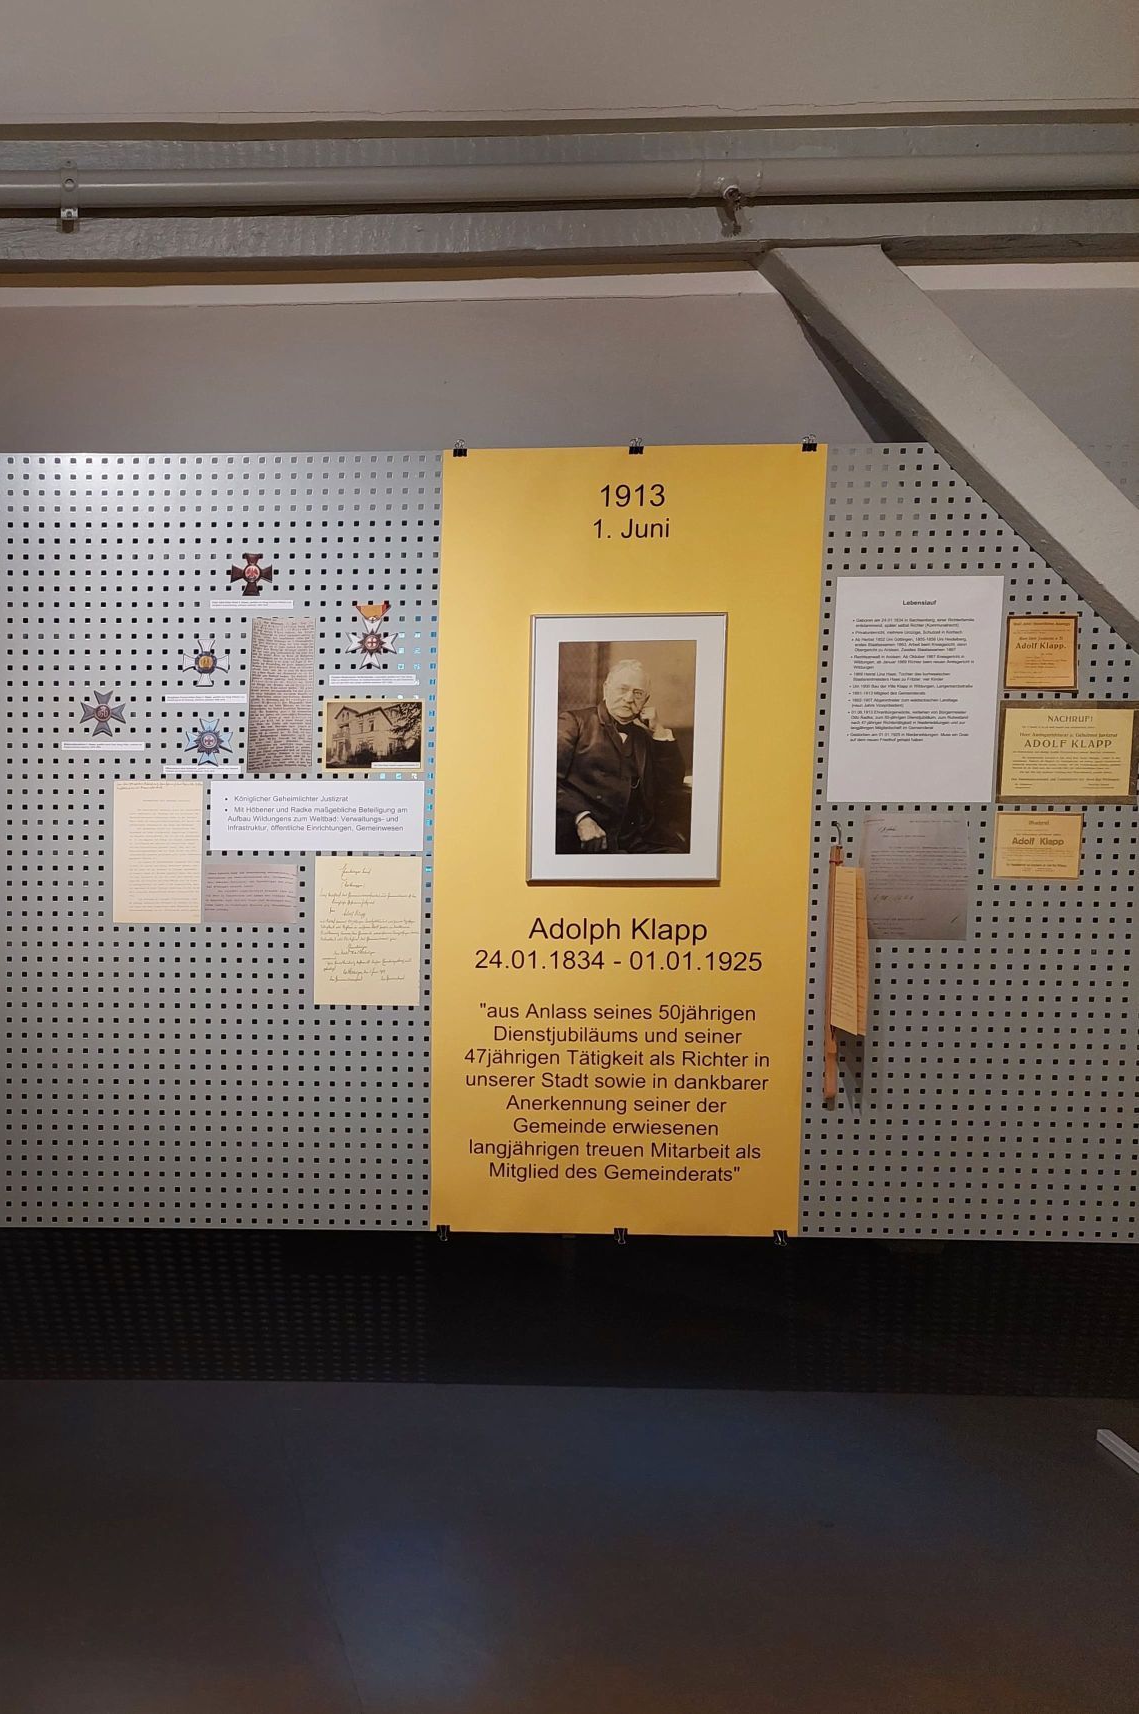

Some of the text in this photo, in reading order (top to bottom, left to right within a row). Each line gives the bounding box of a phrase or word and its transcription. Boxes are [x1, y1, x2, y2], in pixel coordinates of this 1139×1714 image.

[601, 484, 664, 507] 1913
[594, 518, 669, 538] 1. Juni
[1024, 740, 1112, 748] ADOLF KLAPP
[1040, 838, 1064, 846] Klapp
[529, 918, 707, 946] Adolph Klapp
[475, 950, 604, 969] 24.01.1834
[630, 951, 762, 971] 01.01.1925
[480, 1003, 755, 1024] "aus Anlass seines 50jährigen
[494, 1026, 742, 1046] Dienstjubiläums und seiner
[464, 1048, 769, 1069] 47jährigen Tätigkeit als Richter in
[466, 1072, 768, 1090] unserer Stadt sowie in dankbarer
[506, 1095, 726, 1114] Anerkennung seiner der
[514, 1118, 718, 1135] Gemeinde erwiesenen
[470, 1139, 760, 1160] langjährigen treuen Mitarbeit als
[490, 1162, 740, 1182] Mitglied des Gemeinderats"
